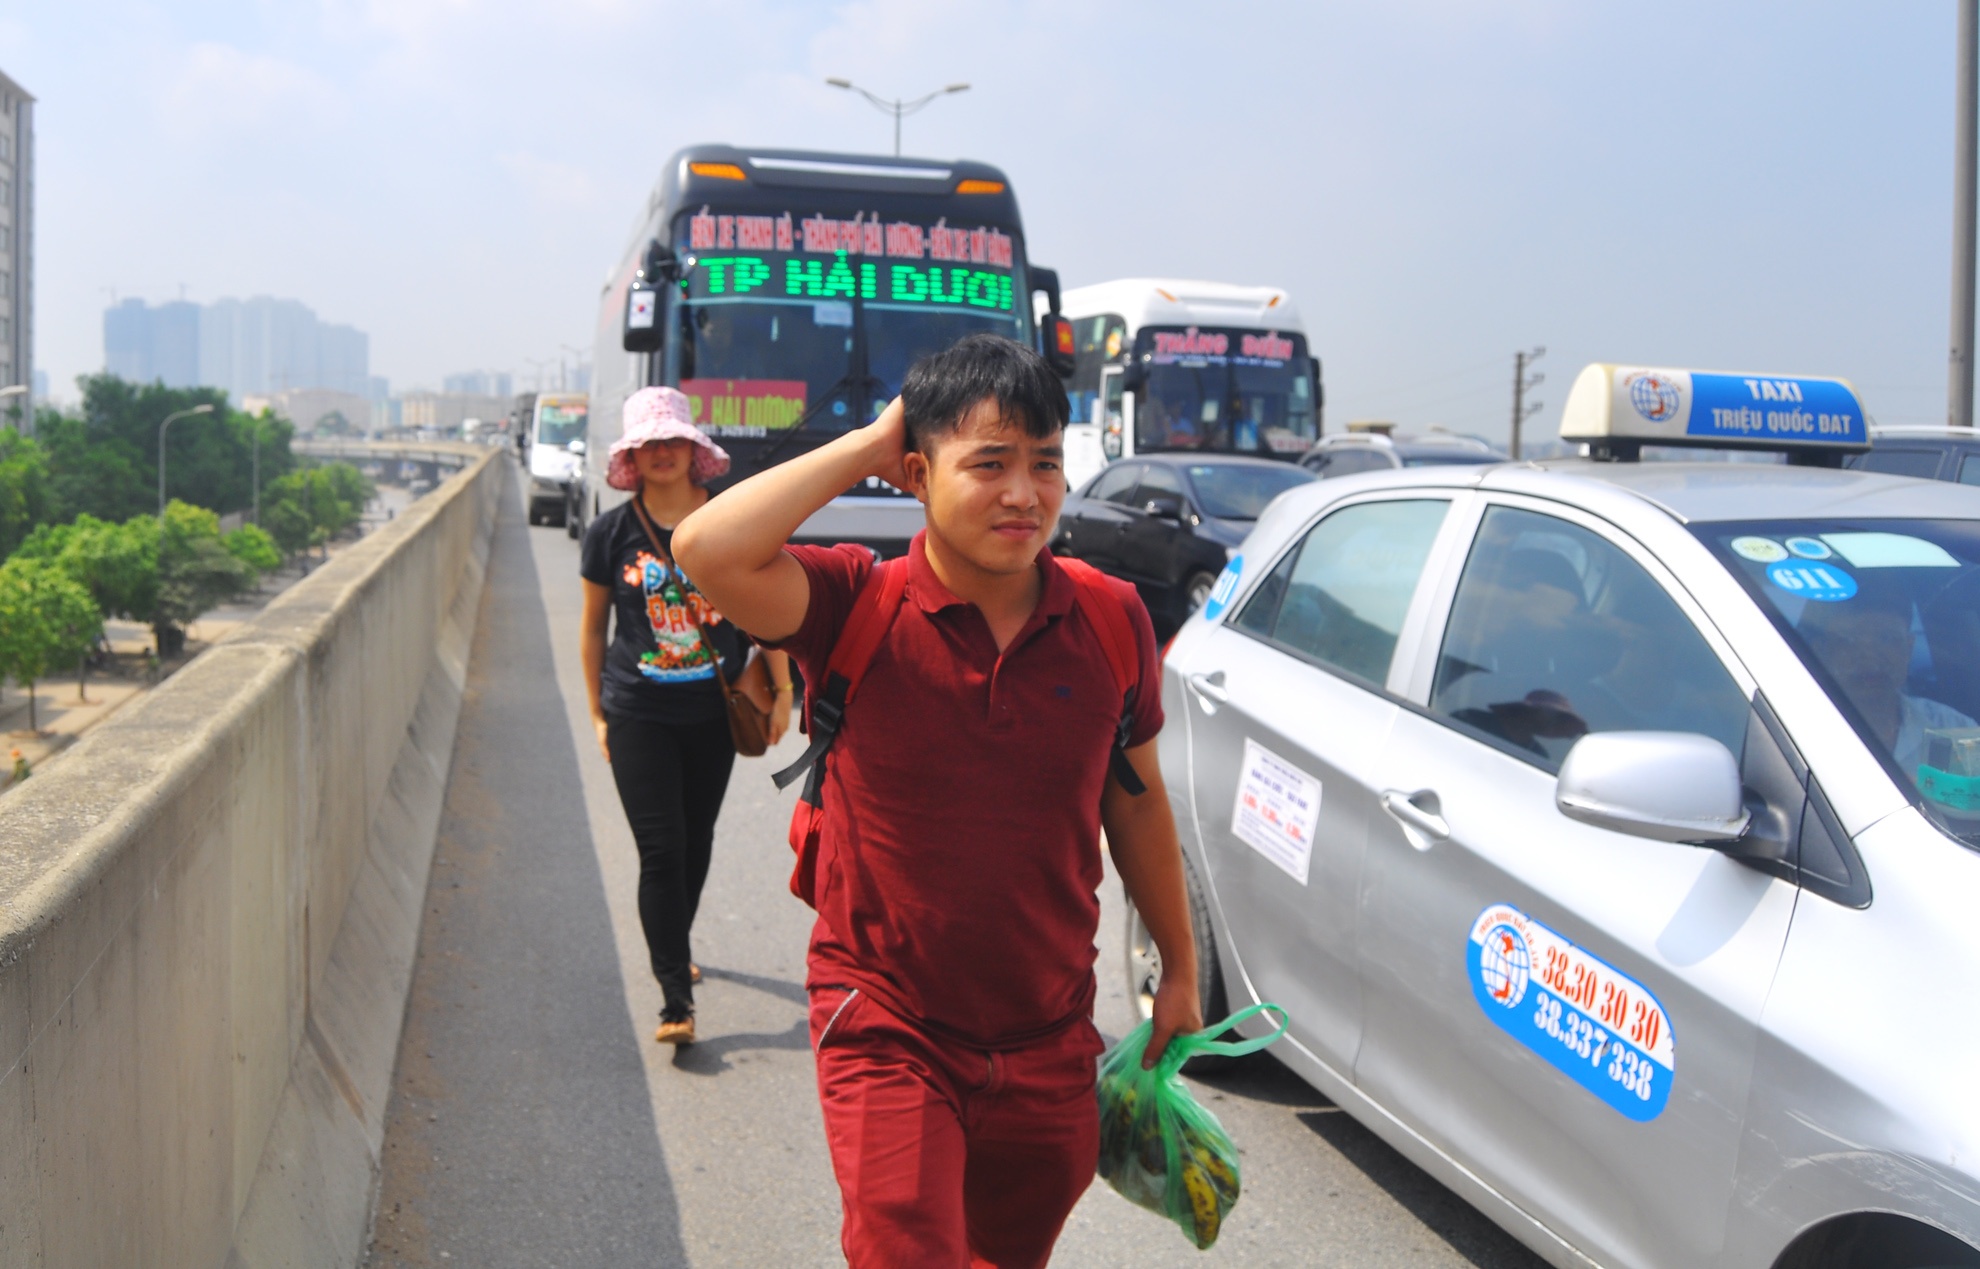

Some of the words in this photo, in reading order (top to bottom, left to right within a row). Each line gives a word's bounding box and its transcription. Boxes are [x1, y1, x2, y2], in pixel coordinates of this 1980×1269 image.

[717, 215, 735, 249] XE
[698, 257, 770, 293] TP
[785, 249, 877, 299] HẢI
[1744, 379, 1803, 402] TAXI
[1711, 405, 1763, 434] TRIỆU
[1766, 407, 1815, 433] QUỐC
[1772, 567, 1844, 590] 611
[1542, 945, 1598, 1010] 38.30
[1600, 981, 1628, 1030] 30
[1631, 1000, 1660, 1050] 30
[1534, 991, 1609, 1067] 38.337
[1608, 1042, 1654, 1101] 338
